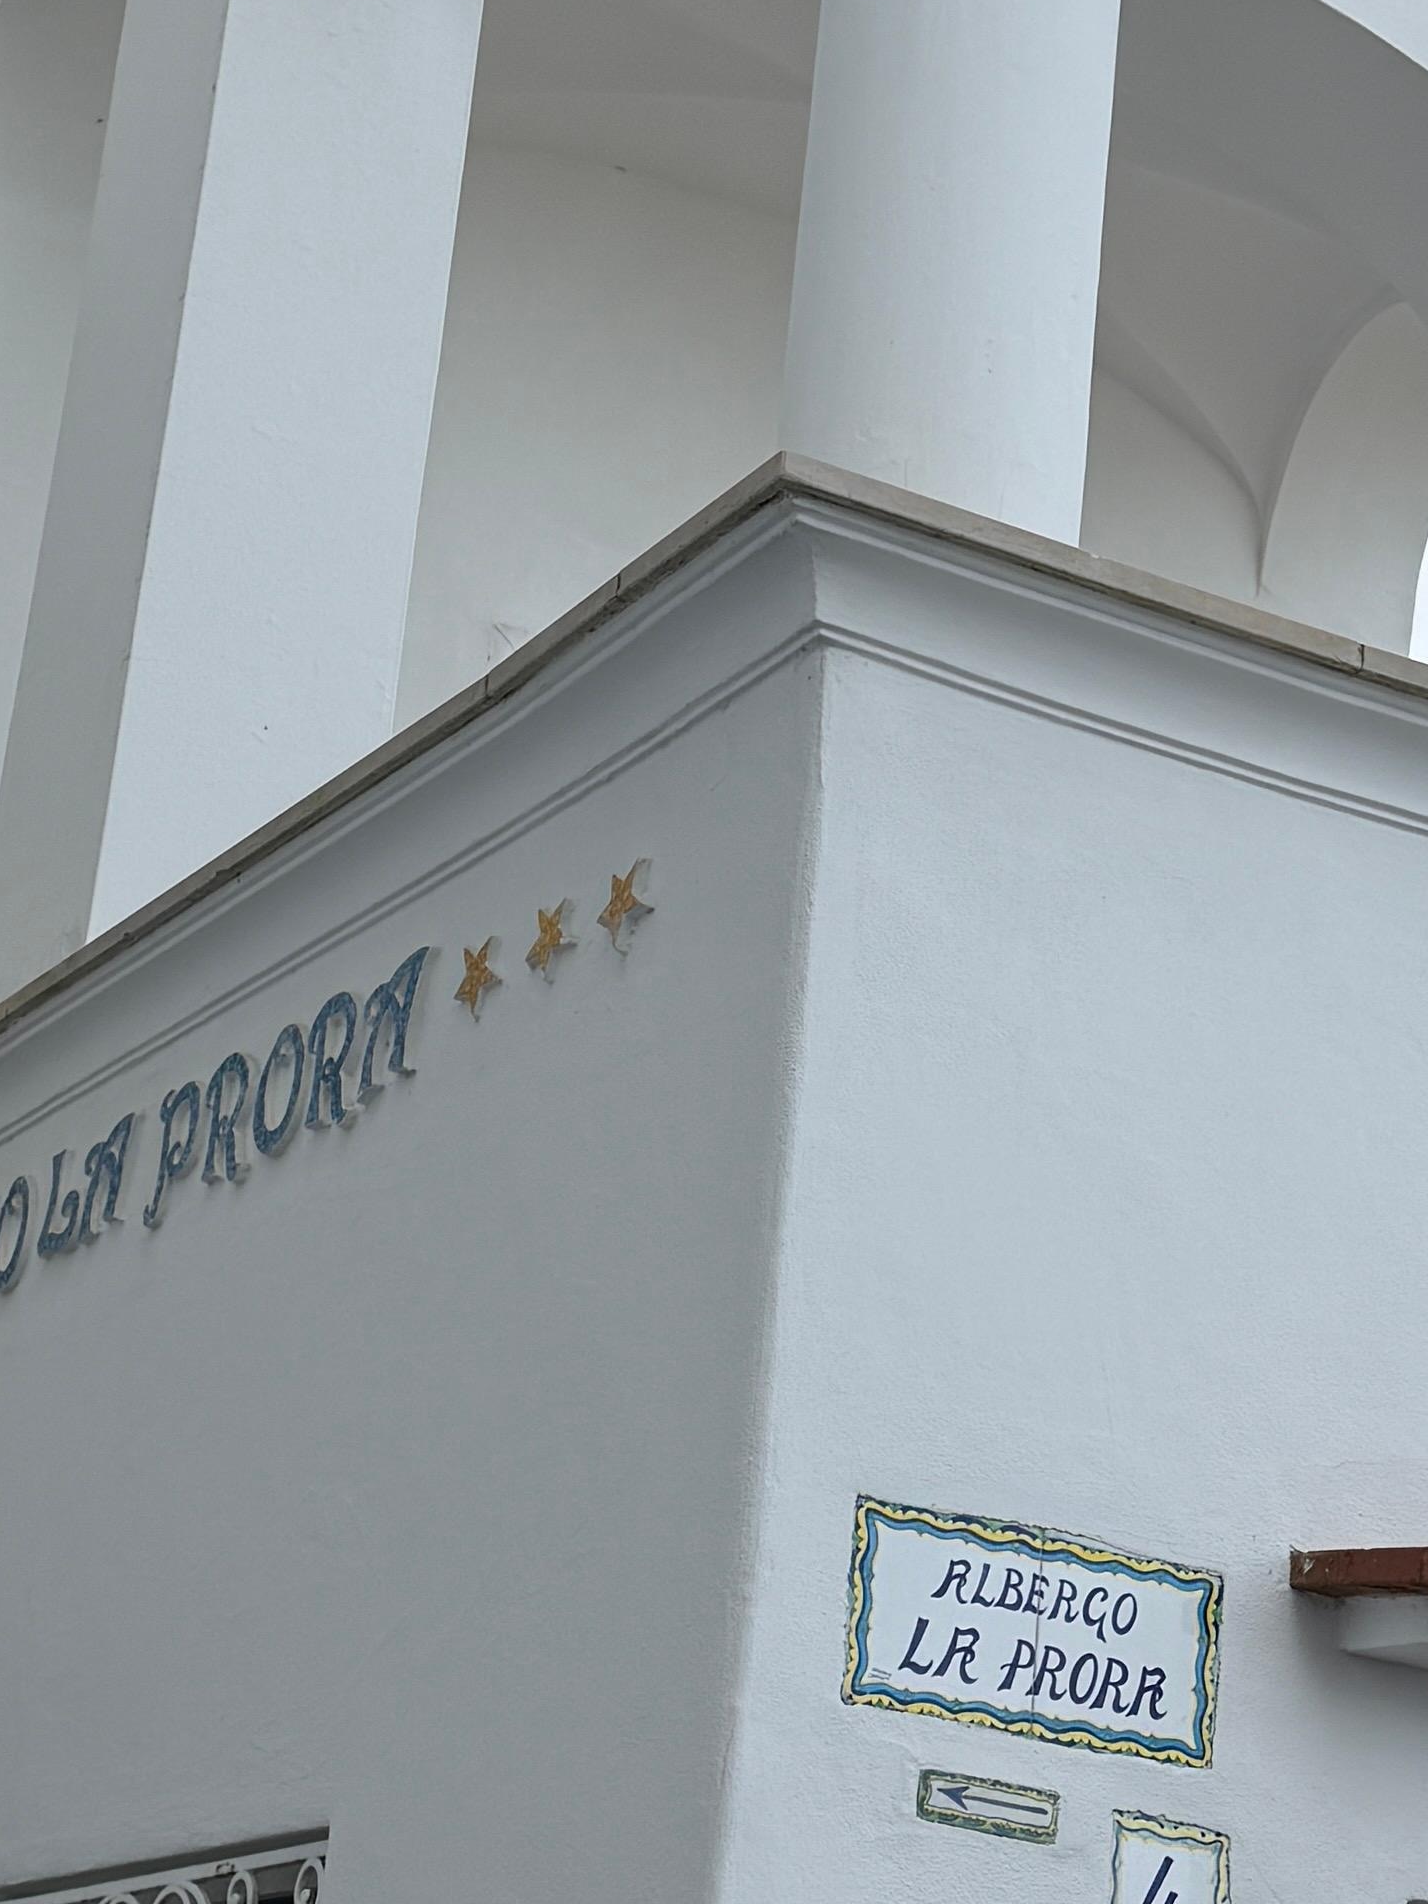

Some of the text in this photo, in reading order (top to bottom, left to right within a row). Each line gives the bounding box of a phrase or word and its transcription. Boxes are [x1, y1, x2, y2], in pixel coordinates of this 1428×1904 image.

[38, 1113, 134, 1258] LA
[143, 946, 432, 1228] PRORA
[931, 1559, 1139, 1642] ALBERGO
[898, 1617, 1169, 1721] LA PRORA
